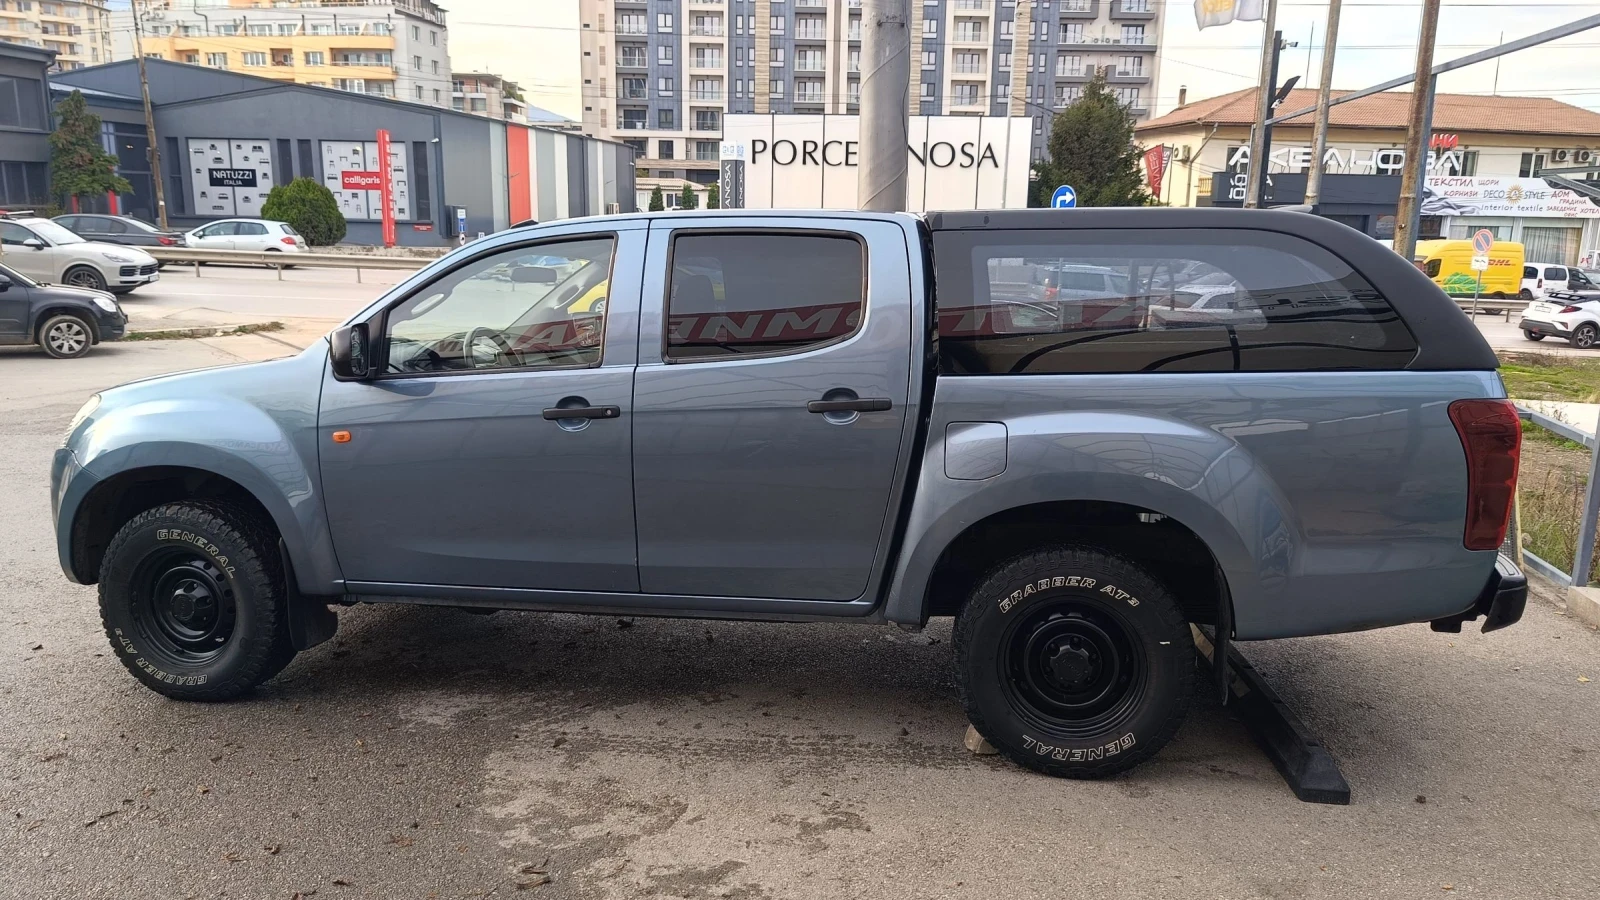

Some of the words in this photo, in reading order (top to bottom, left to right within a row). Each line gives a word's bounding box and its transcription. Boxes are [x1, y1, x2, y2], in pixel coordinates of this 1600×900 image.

[751, 138, 999, 169] PORCENOSA
[213, 170, 253, 179] NATUZZI
[344, 175, 381, 186] calligaris
[1428, 178, 1474, 187] ТЕКСТИЛ
[1483, 190, 1506, 199] DECO
[1523, 190, 1546, 200] STYLE
[1550, 190, 1571, 199] ДОМ
[1517, 204, 1544, 212] textile
[157, 529, 236, 579] GENERAL
[999, 576, 1097, 613] GRABBER
[135, 657, 208, 685] GRABBER
[1022, 732, 1136, 761] GENERAL
